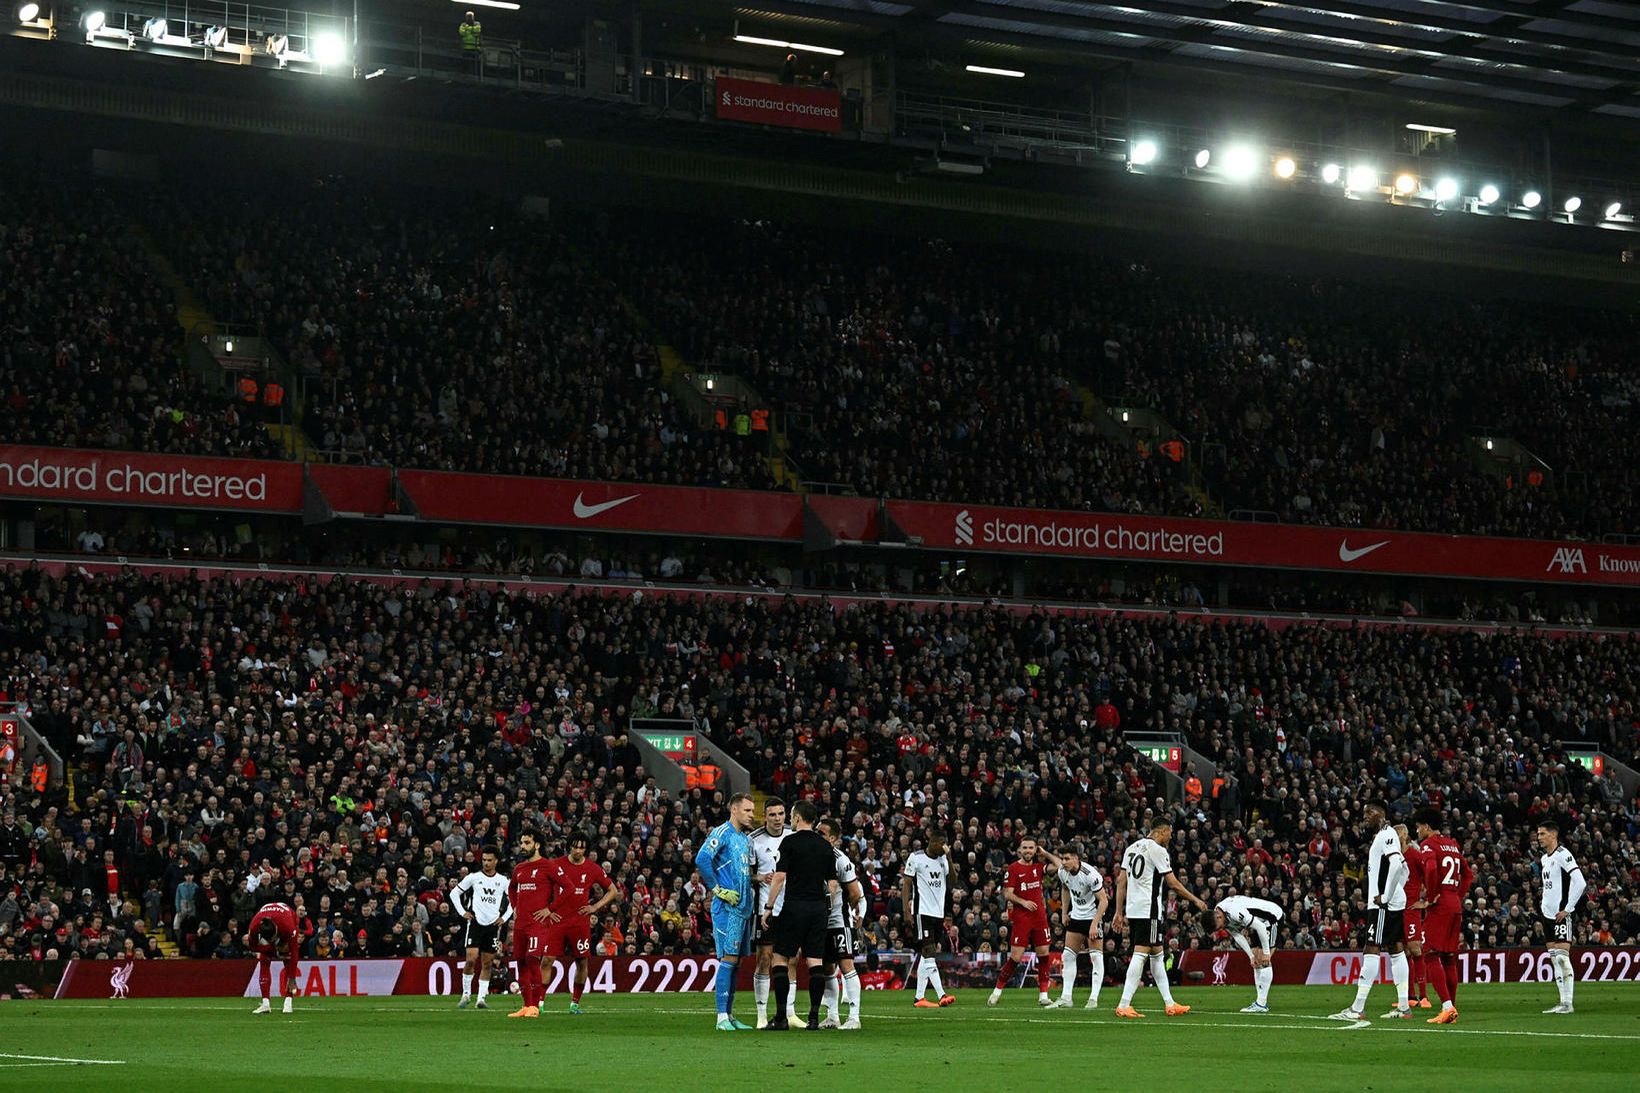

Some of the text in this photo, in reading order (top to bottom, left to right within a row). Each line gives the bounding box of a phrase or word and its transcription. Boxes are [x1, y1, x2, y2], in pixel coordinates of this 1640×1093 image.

[734, 95, 838, 118] standard chartered
[105, 464, 266, 501] chartered
[983, 518, 1223, 555] standard chartered
[1546, 547, 1588, 574] AXA
[5, 723, 14, 735] 3
[686, 740, 693, 749] 4
[1368, 924, 1375, 936] 4
[1409, 923, 1416, 935] 3
[1554, 924, 1567, 936] 28
[530, 936, 538, 949] 11
[577, 939, 590, 950] 66
[1458, 952, 1506, 984] 151
[1518, 952, 1554, 983] 26
[279, 965, 368, 997] CALL
